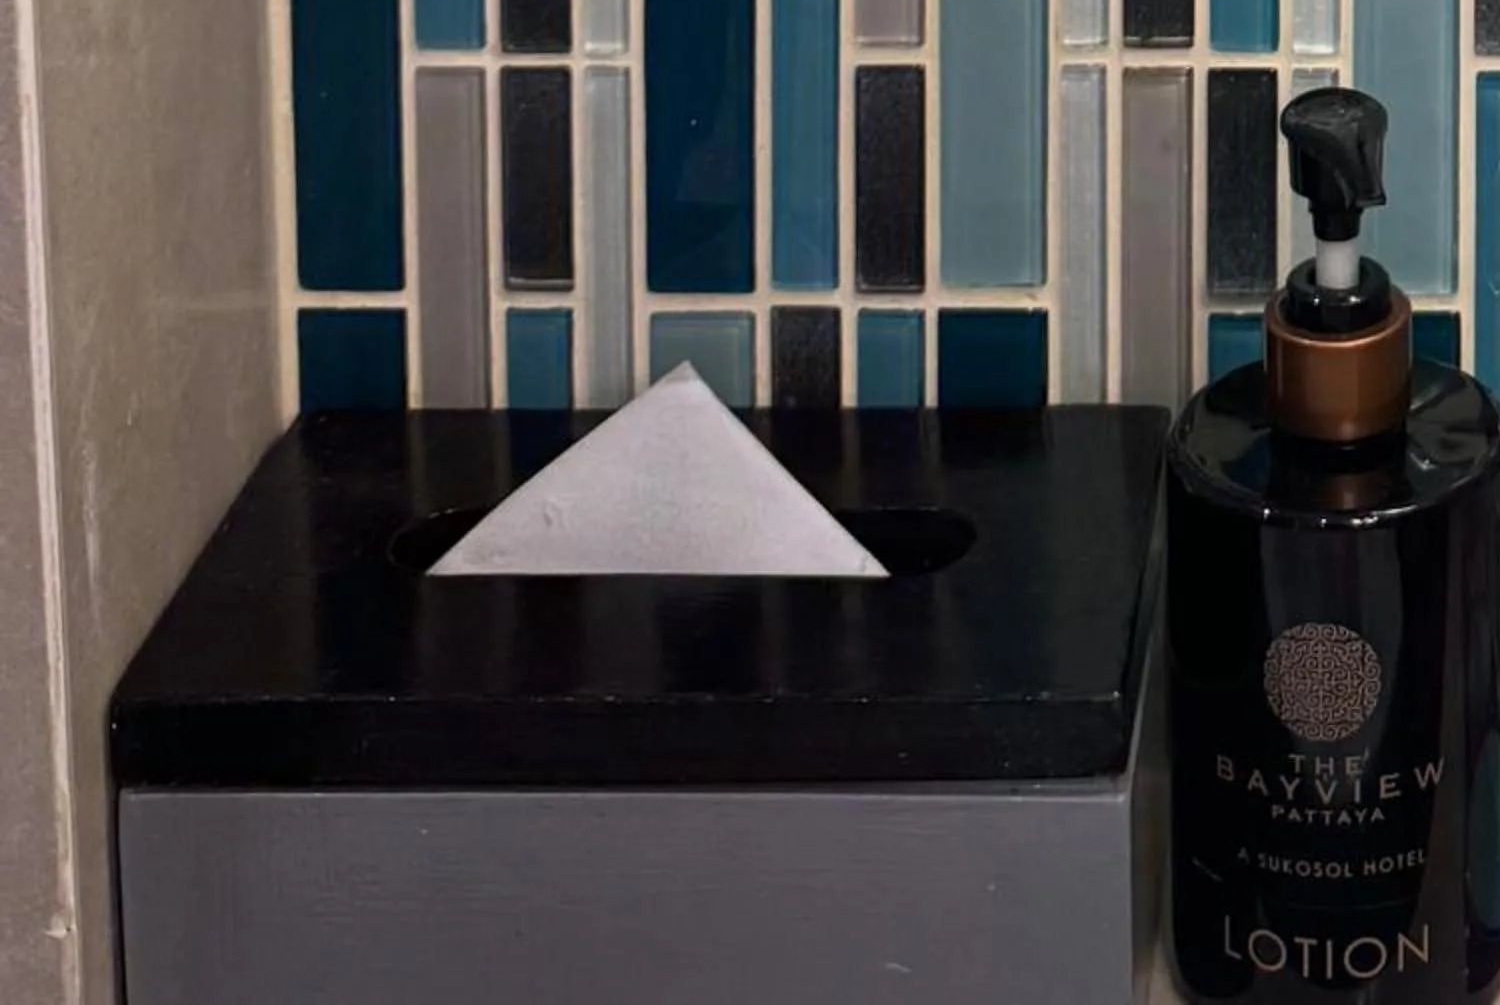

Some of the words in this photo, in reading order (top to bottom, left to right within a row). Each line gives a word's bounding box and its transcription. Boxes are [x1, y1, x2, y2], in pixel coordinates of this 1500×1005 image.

[1217, 755, 1445, 803] BAYVIEW
[1289, 755, 1363, 774] THE
[1272, 804, 1385, 825] PATTAYA
[1238, 847, 1250, 862] A
[1258, 853, 1352, 878] SUKOSOL
[1363, 848, 1426, 874] HOTEL
[1225, 915, 1429, 979] LOTION
